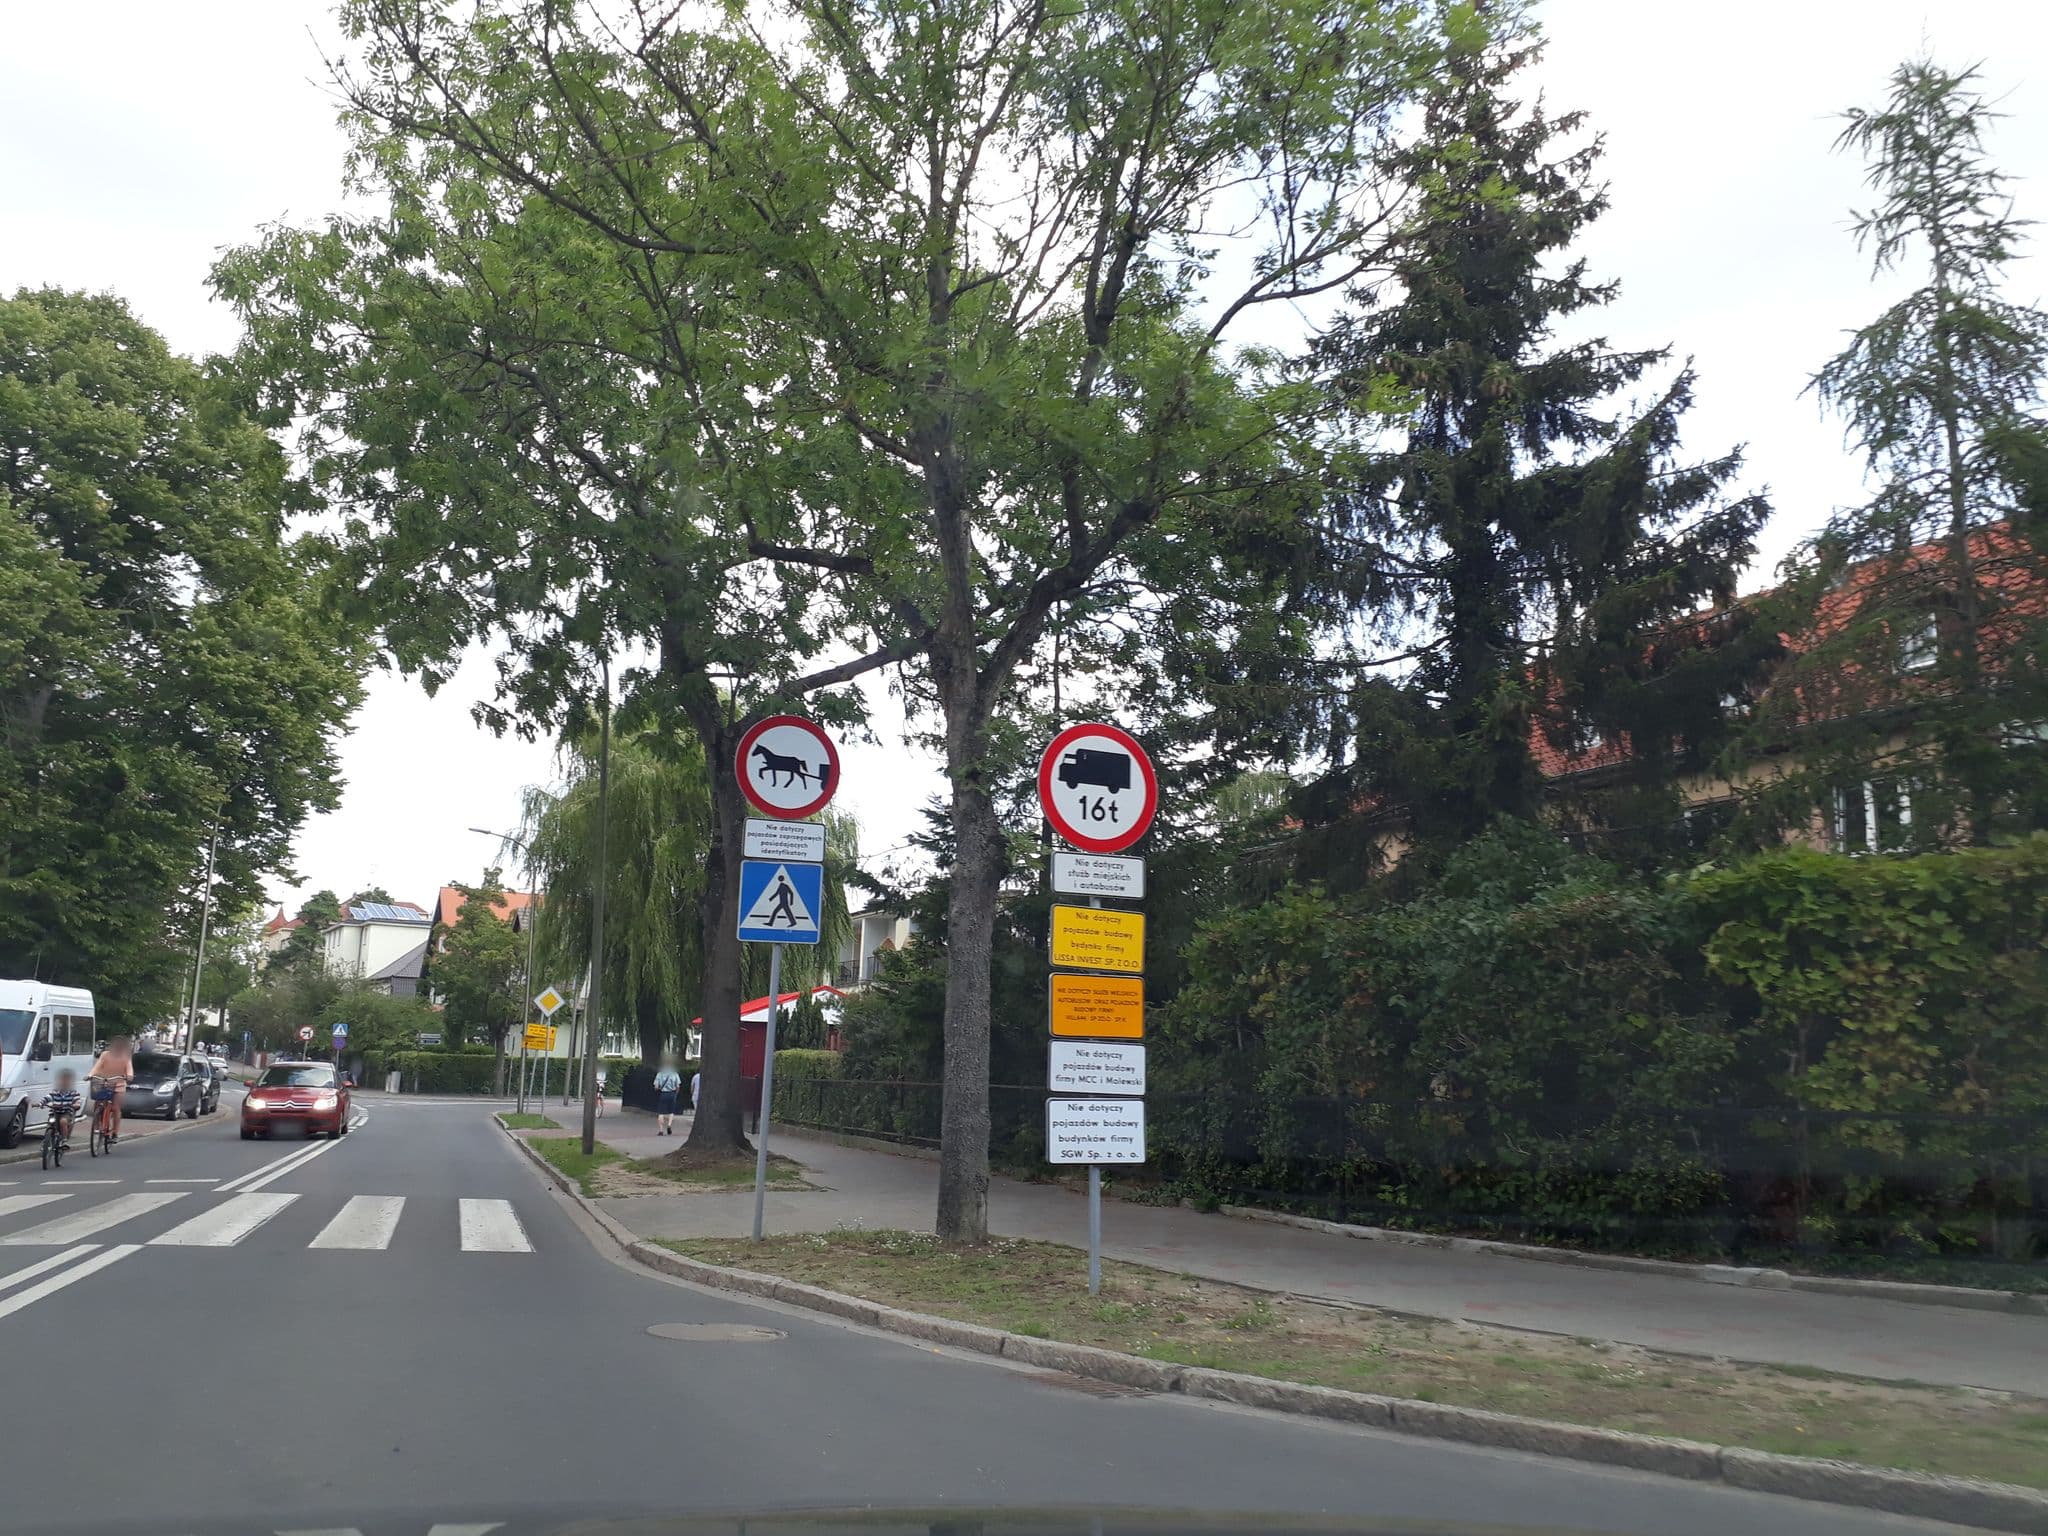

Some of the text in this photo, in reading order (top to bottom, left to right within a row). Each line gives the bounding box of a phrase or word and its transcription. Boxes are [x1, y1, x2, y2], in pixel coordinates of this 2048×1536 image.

[1075, 858, 1125, 871] Nie dotyczy
[1075, 911, 1089, 920] Nie
[1076, 1049, 1123, 1060] Nie dotyczy
[1104, 1063, 1135, 1073] budowy
[1055, 1074, 1076, 1083] firmy
[1078, 1075, 1098, 1083] MCC
[1067, 1103, 1124, 1114] Nie dotyczy
[1052, 1118, 1139, 1128] pojazdów budowy
[1058, 1134, 1134, 1144] budynków firmy
[1060, 1150, 1083, 1158] SGW
[1087, 1150, 1102, 1160] Sp.
